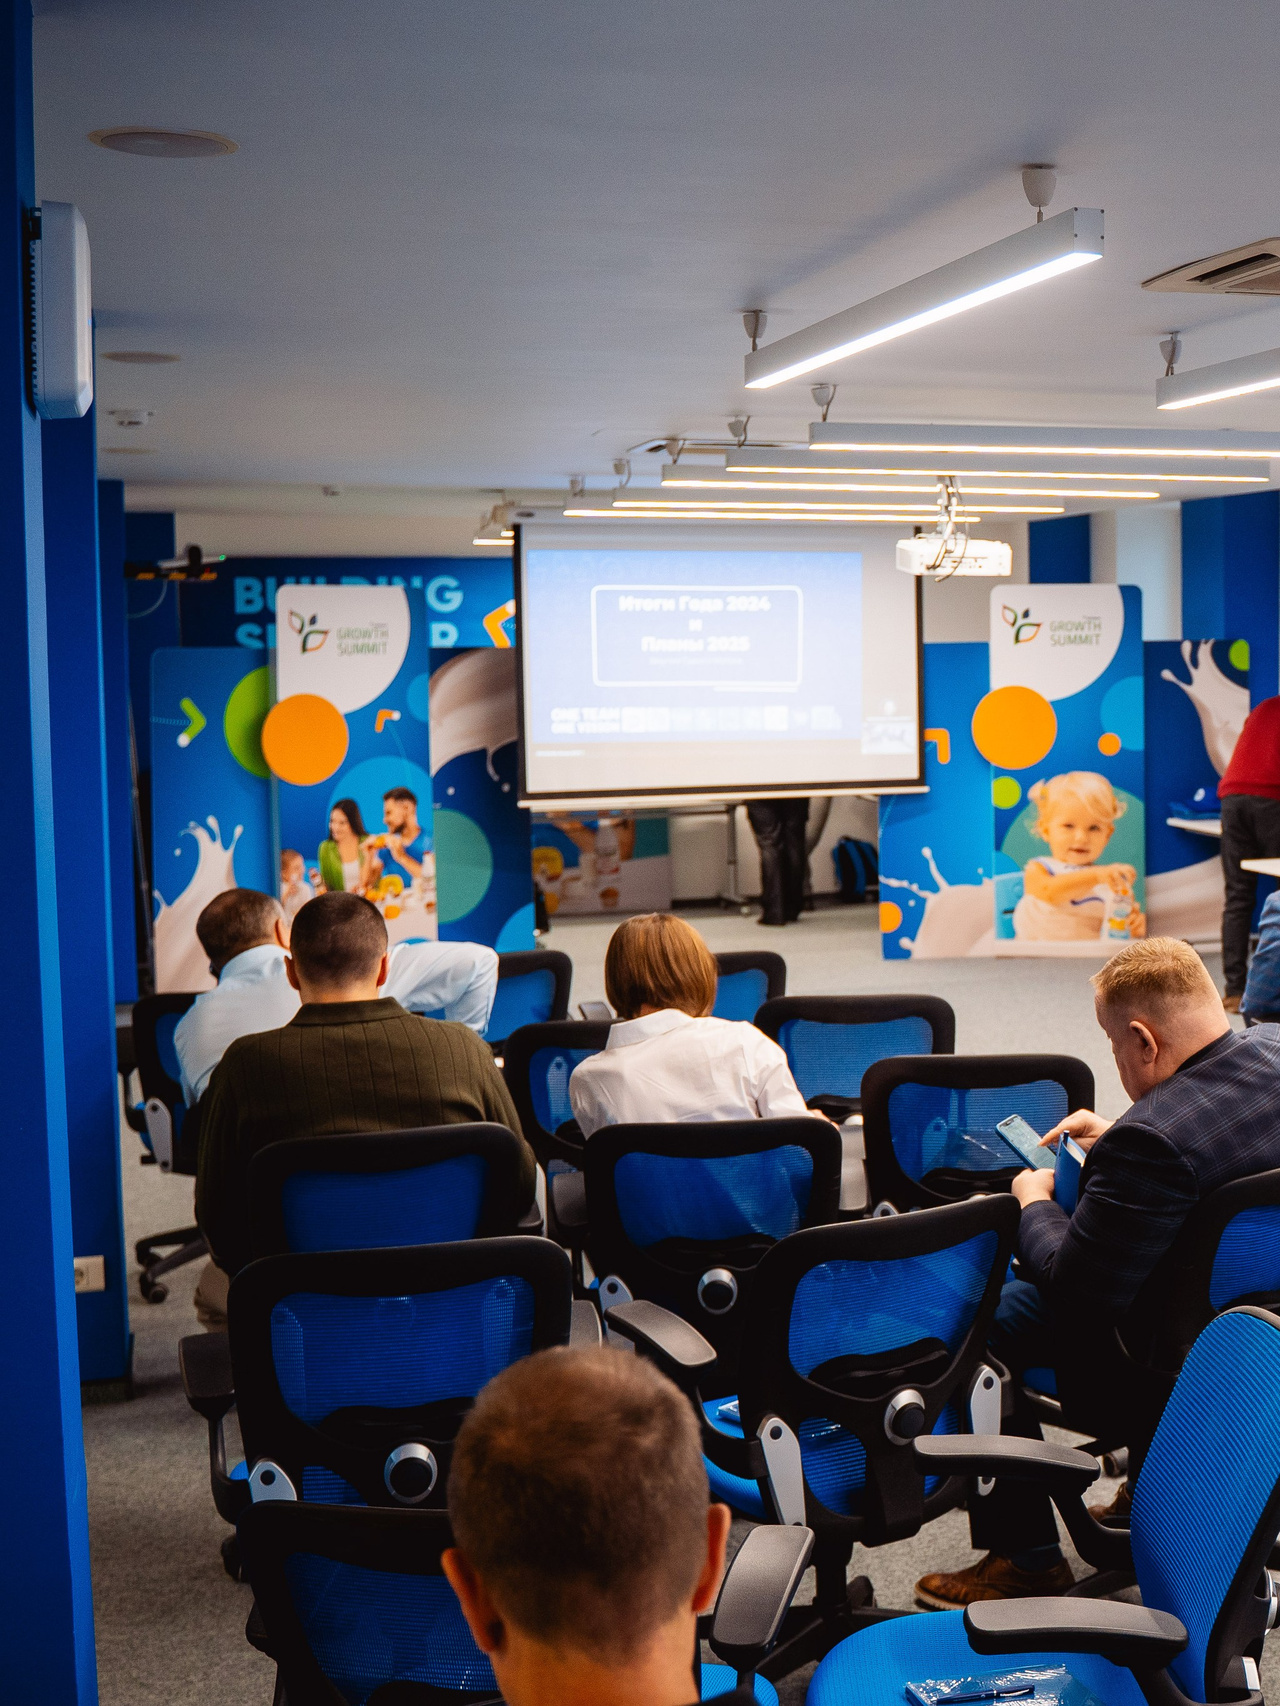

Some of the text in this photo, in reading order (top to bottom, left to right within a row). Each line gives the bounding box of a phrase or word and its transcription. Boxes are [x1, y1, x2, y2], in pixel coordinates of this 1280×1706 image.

[619, 595, 772, 613] Итоги Года 2024
[1050, 620, 1102, 633] GROWTH
[641, 636, 750, 652] Планы 2025
[1050, 633, 1102, 647] SUMMIT
